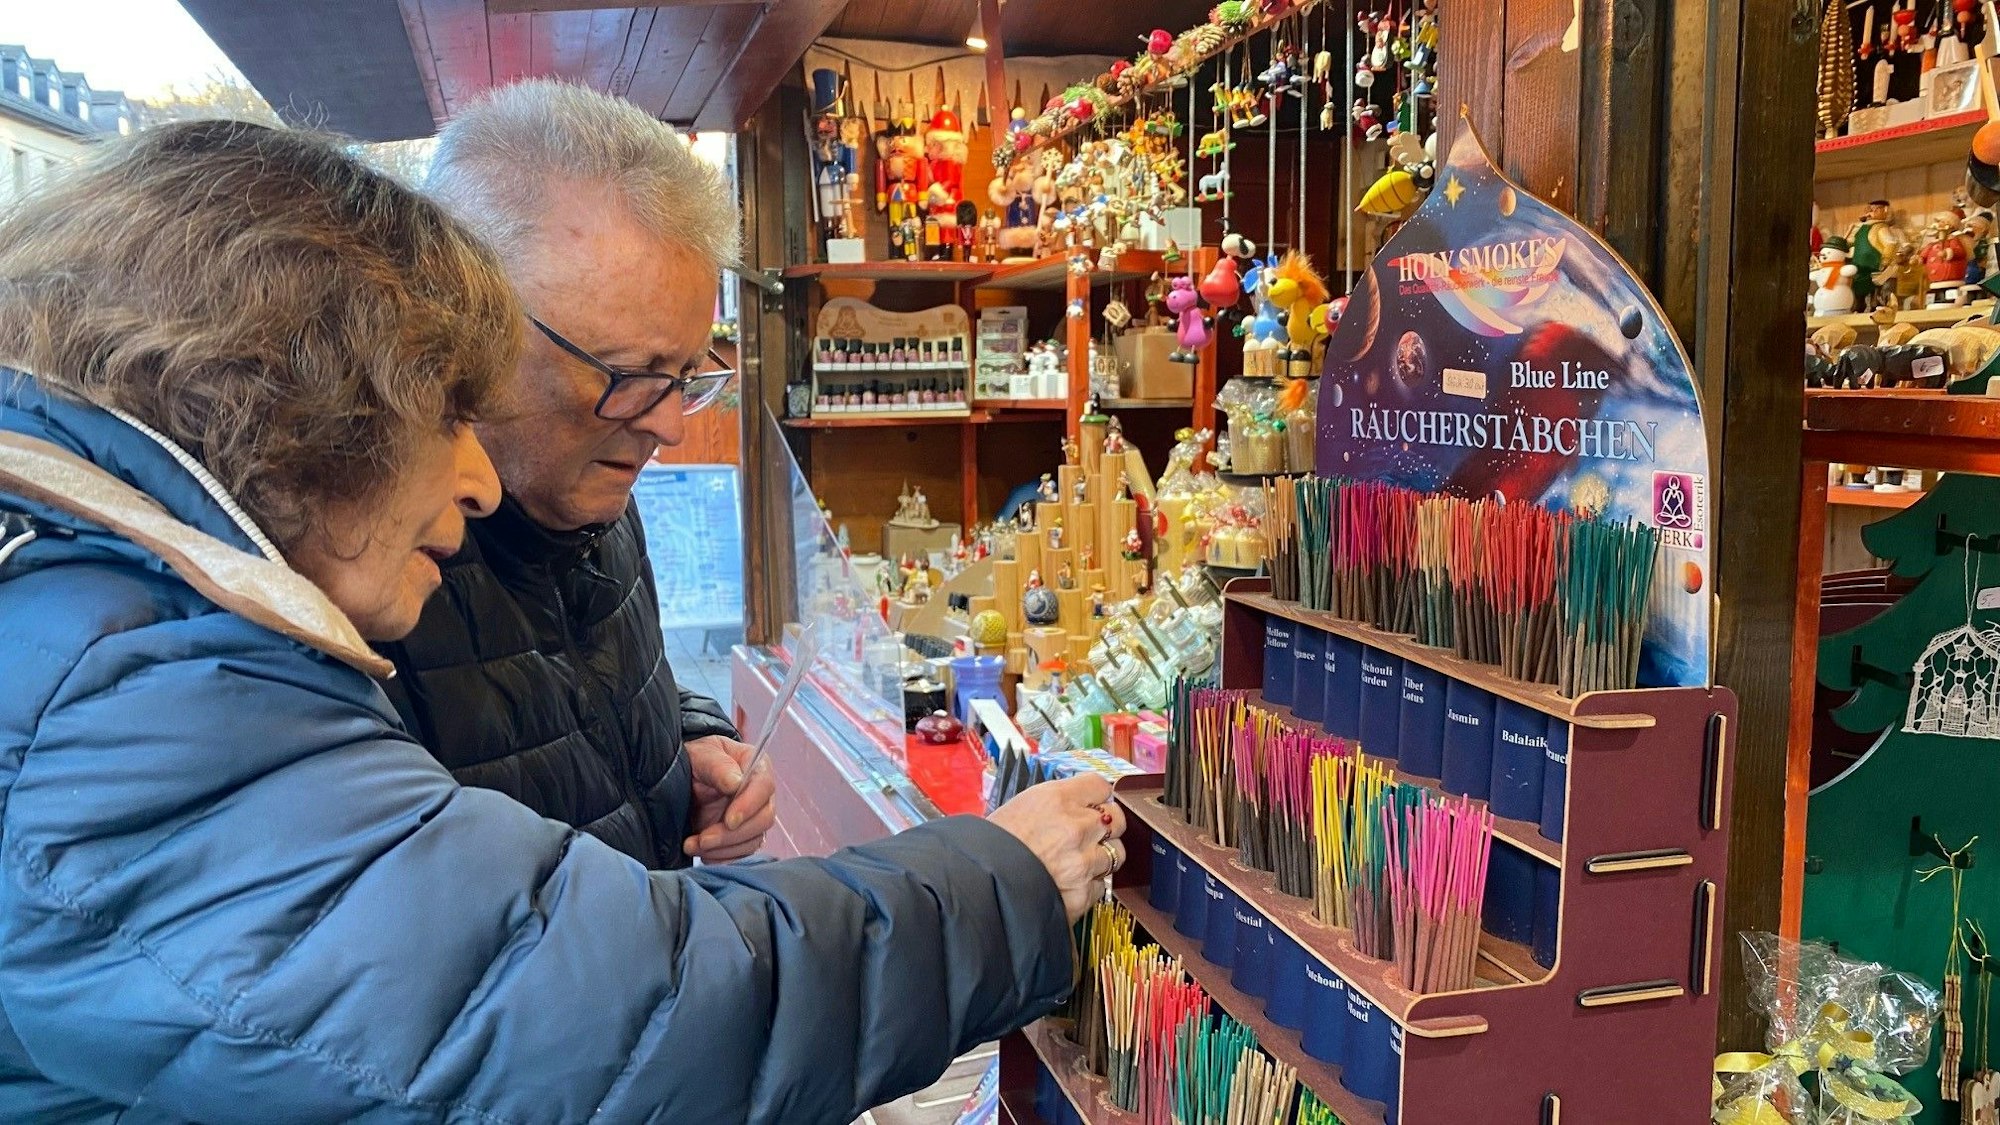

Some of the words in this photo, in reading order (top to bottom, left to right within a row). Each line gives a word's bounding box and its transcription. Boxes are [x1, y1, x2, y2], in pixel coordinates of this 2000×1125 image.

[1399, 250, 1454, 282] HOLY
[1458, 237, 1558, 276] SMOKES
[1510, 360, 1556, 388] Blue
[1561, 361, 1610, 390] Line
[1350, 402, 1658, 462] RÄUCHERSTÄBCHEN
[1694, 476, 1704, 532] Esoterik
[1402, 689, 1424, 704] Lotus
[1404, 677, 1424, 692] Tibet
[1502, 729, 1549, 748] Balalaik
